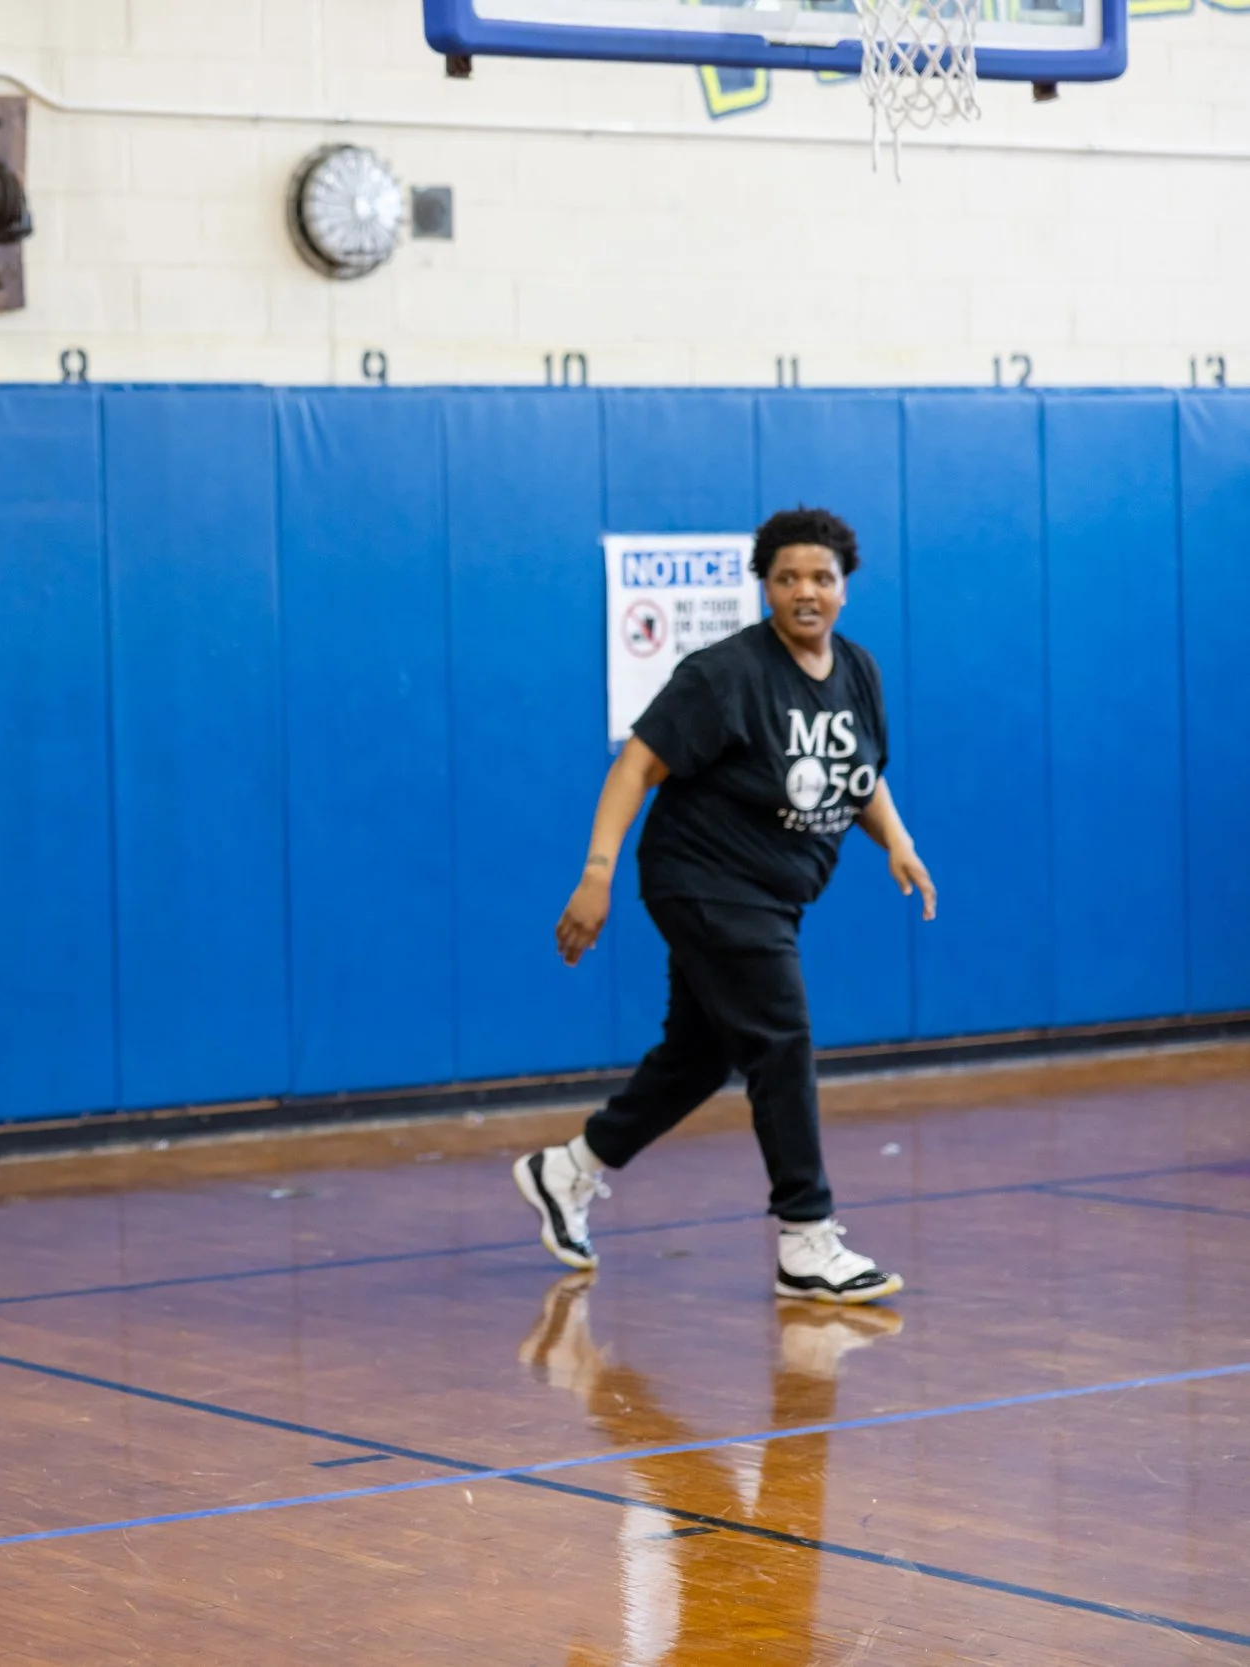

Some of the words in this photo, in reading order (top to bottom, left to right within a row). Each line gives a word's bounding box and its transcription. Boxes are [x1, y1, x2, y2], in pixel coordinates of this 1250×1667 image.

[362, 351, 388, 386] 9
[624, 551, 740, 586] NOTICE
[785, 708, 858, 759] MS
[820, 763, 876, 808] 50
